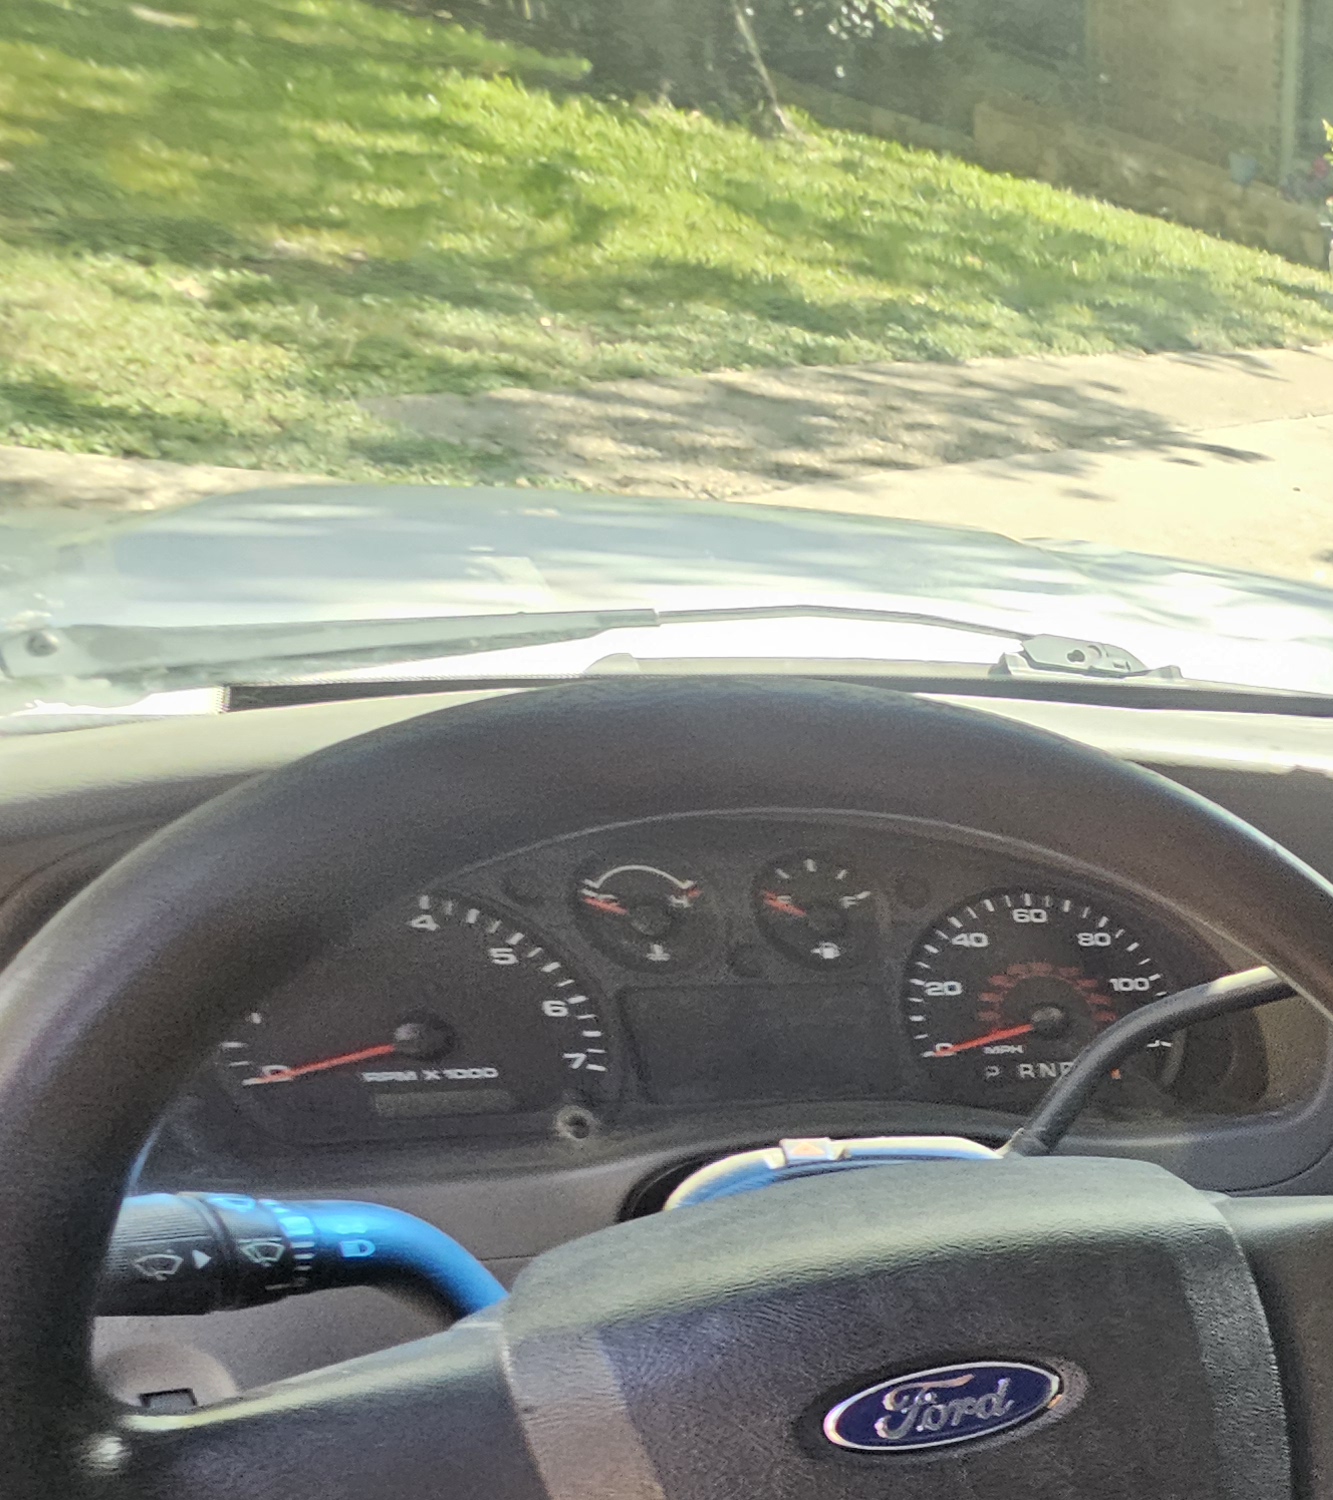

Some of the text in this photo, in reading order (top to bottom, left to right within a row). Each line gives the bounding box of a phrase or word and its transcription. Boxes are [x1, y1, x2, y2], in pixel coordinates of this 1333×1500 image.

[411, 915, 438, 931] 4
[1013, 908, 1048, 924] 60
[951, 932, 989, 948] 40
[1077, 932, 1111, 947] 80
[490, 947, 518, 965] 5
[925, 980, 963, 996] 20
[1109, 977, 1150, 992] 100
[542, 1000, 568, 1017] 6
[983, 1045, 1024, 1054] MPH
[564, 1053, 587, 1070] 7
[361, 1070, 418, 1082] RPM
[442, 1067, 499, 1080] 1000
[874, 1374, 1014, 1440] Ford
